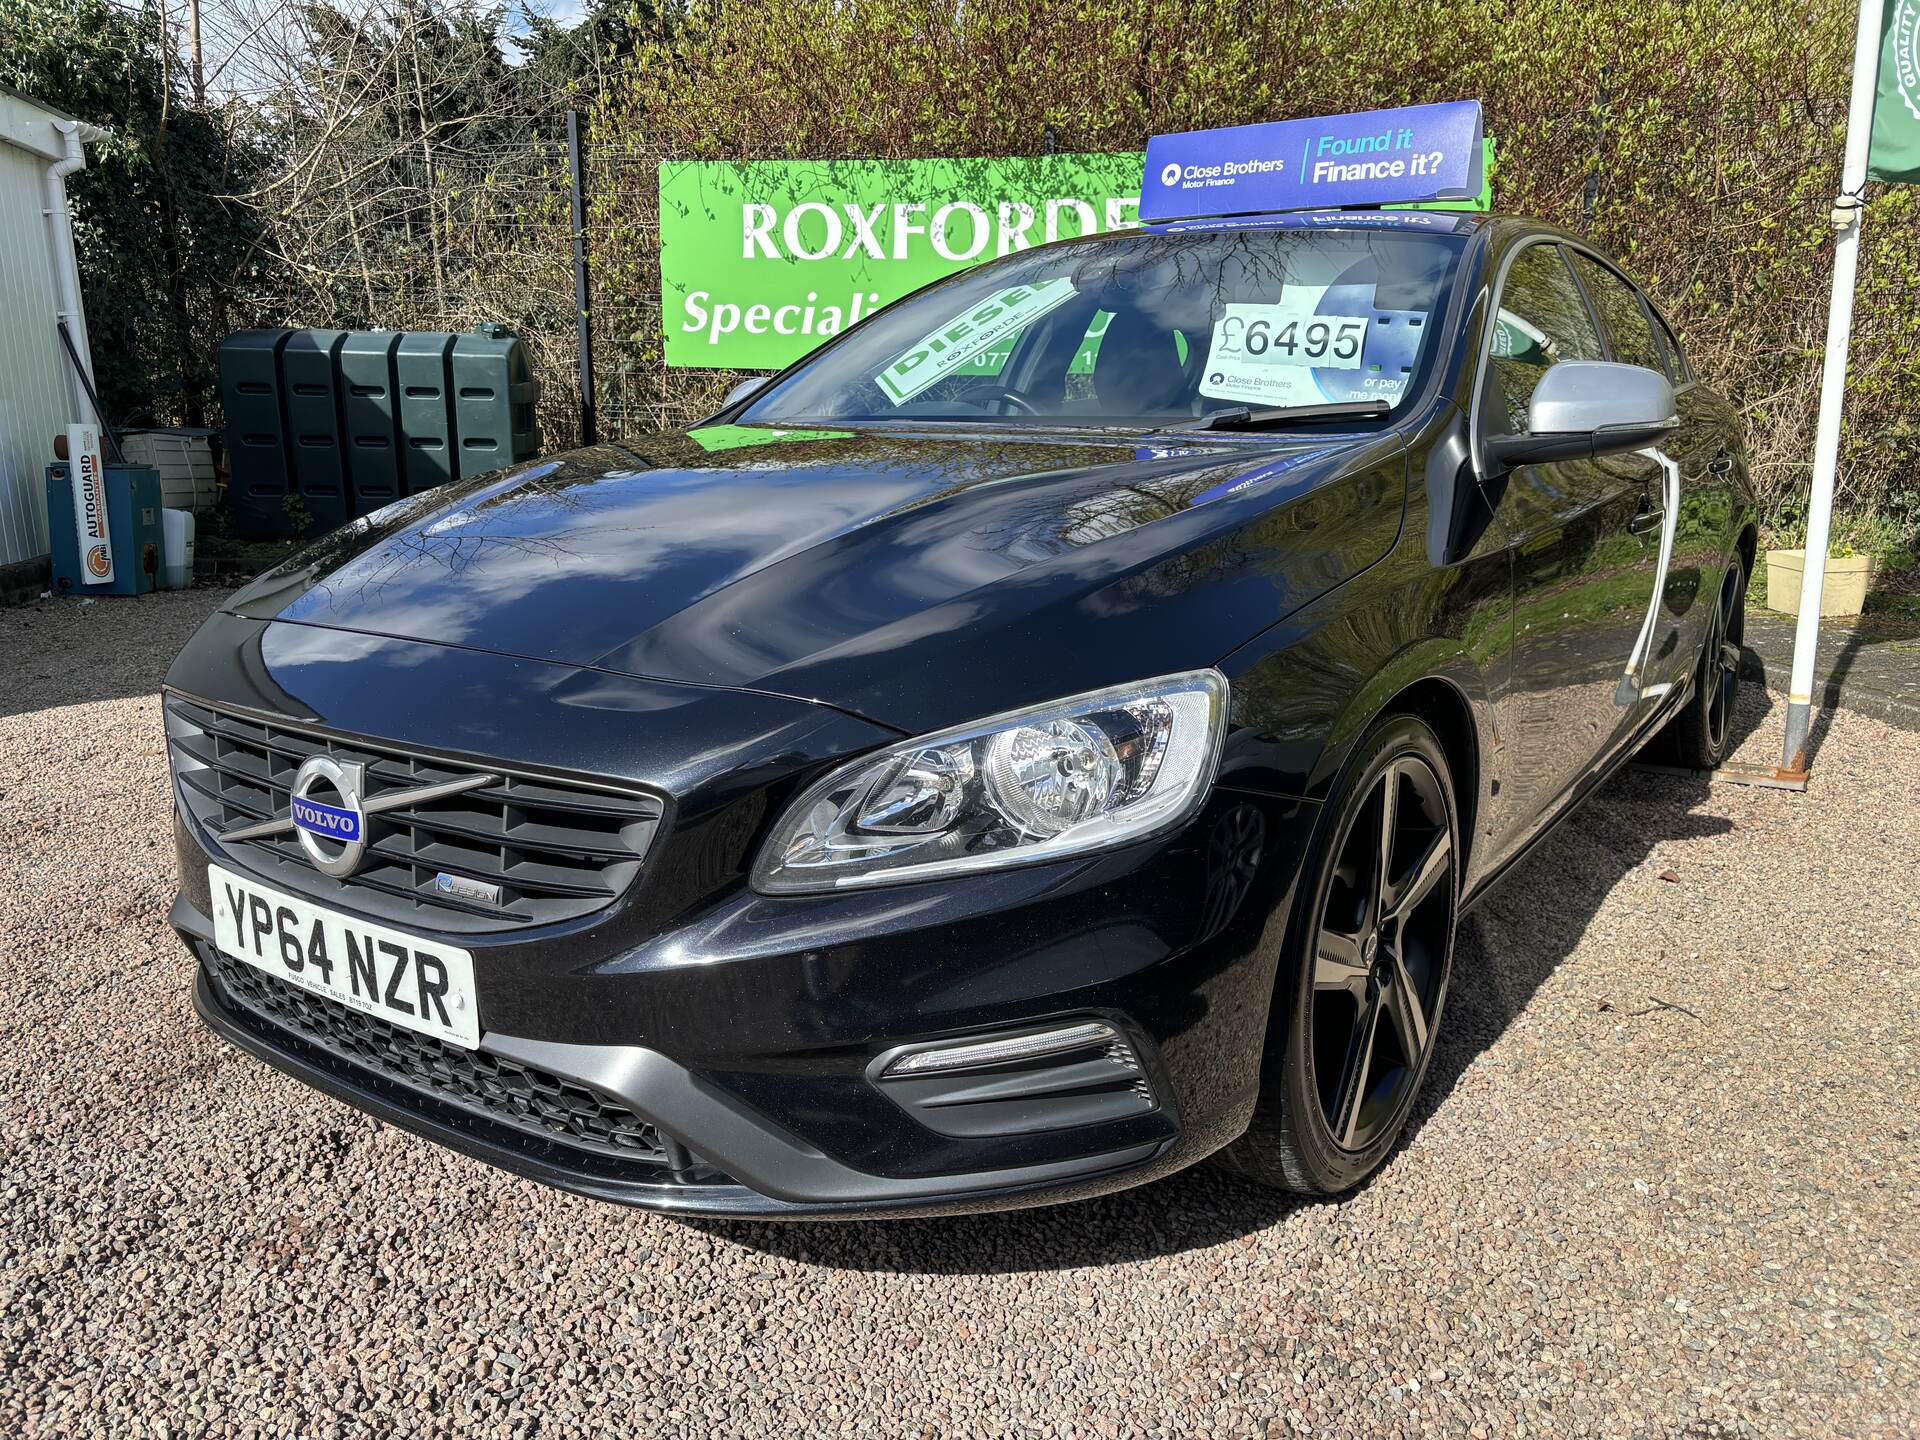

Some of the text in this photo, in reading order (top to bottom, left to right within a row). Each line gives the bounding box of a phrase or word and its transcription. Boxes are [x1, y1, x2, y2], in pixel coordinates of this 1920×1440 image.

[1899, 2, 1917, 88] QUALITY
[1316, 128, 1414, 157] Found it
[1183, 159, 1284, 180] Close Brothers
[1312, 151, 1444, 184] Finance it?
[1182, 177, 1236, 190] Motor Finance
[1218, 315, 1362, 361] £6495
[1227, 374, 1292, 390] Close Brothers
[1364, 377, 1378, 387] or
[1379, 378, 1402, 392] pay
[81, 454, 99, 539] AUTOGUARD
[93, 470, 103, 523] WARRANTIES
[293, 805, 355, 834] VOLVO
[224, 882, 454, 1029] YP64 NZR
[307, 979, 328, 993] VEHICLE
[329, 989, 346, 1001] SALES
